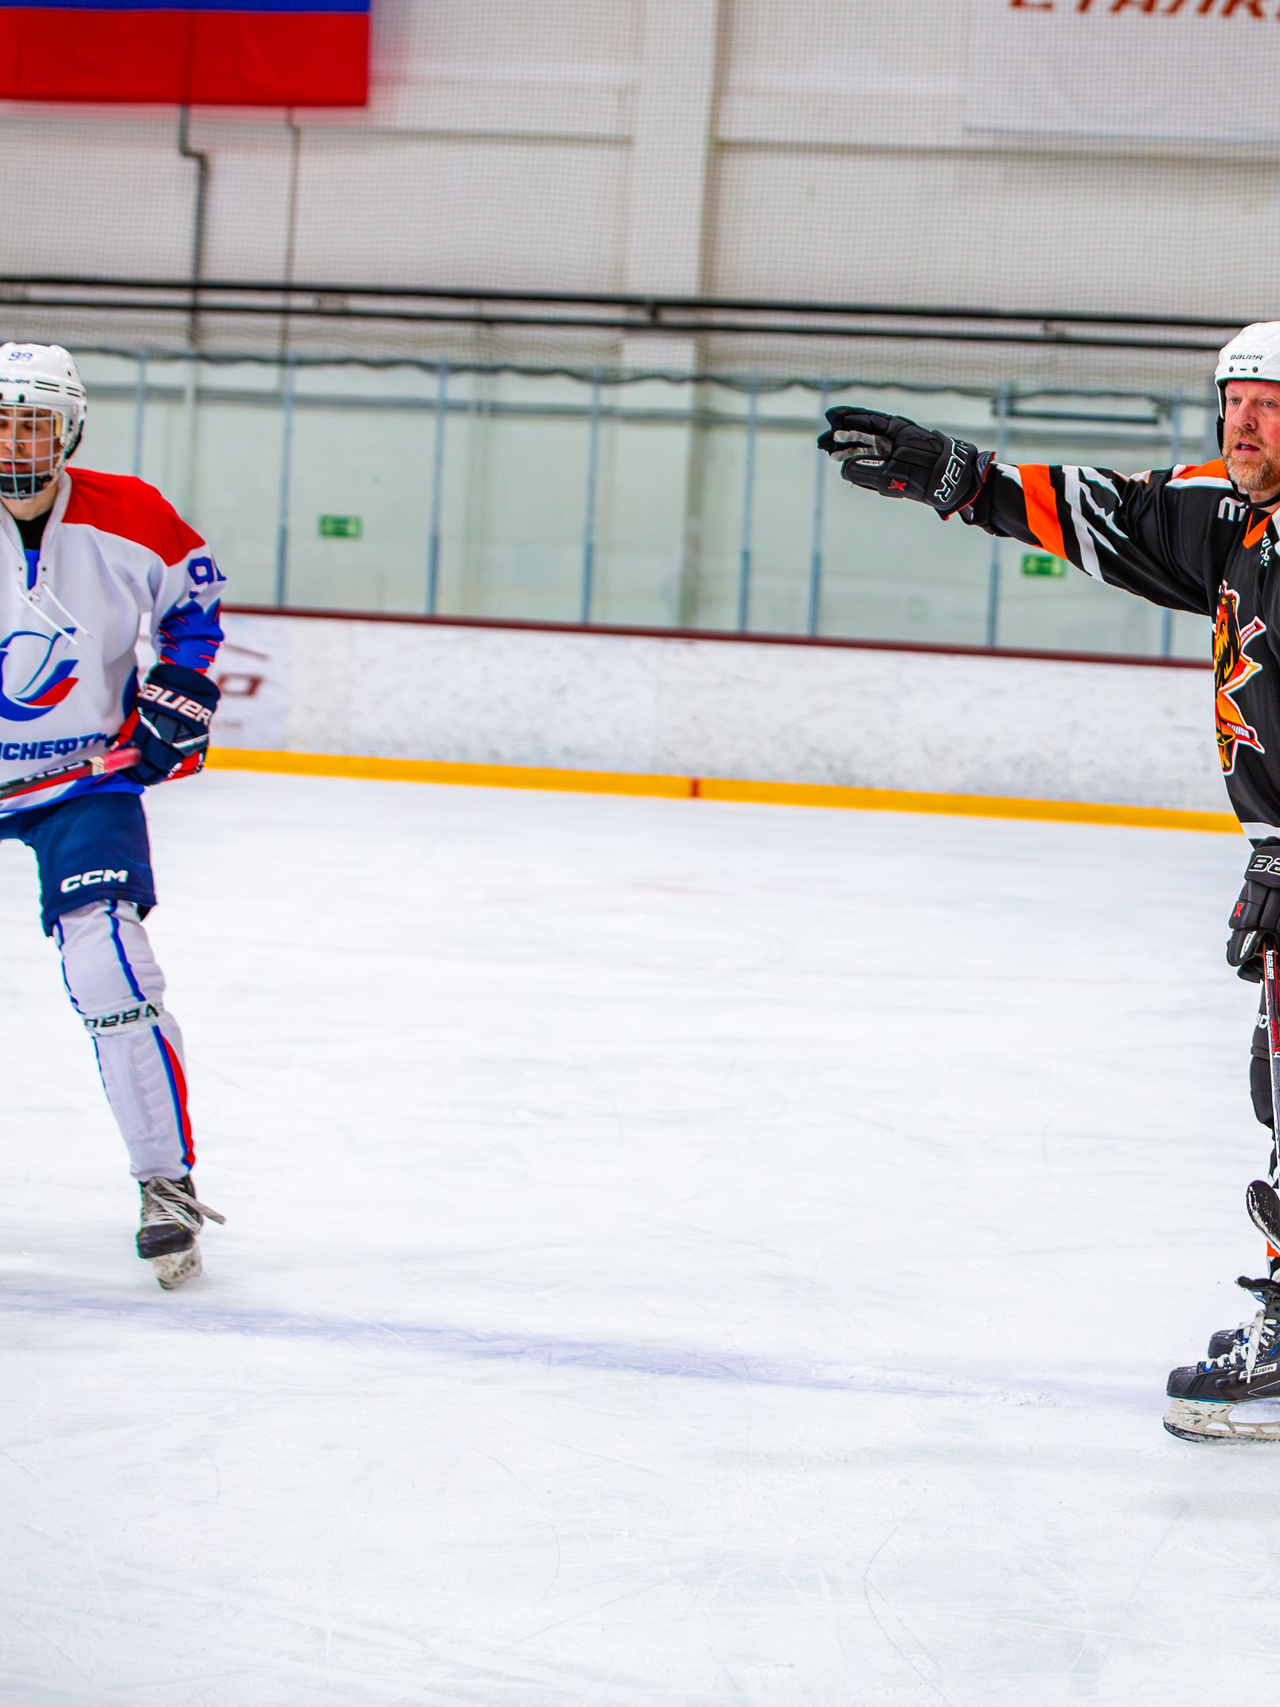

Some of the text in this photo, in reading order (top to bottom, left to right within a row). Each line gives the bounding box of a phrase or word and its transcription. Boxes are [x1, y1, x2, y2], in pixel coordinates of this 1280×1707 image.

[934, 437, 969, 503] UER
[0, 732, 107, 761] СНЕФТ
[60, 869, 129, 894] CCM
[1265, 954, 1275, 980] BAUER
